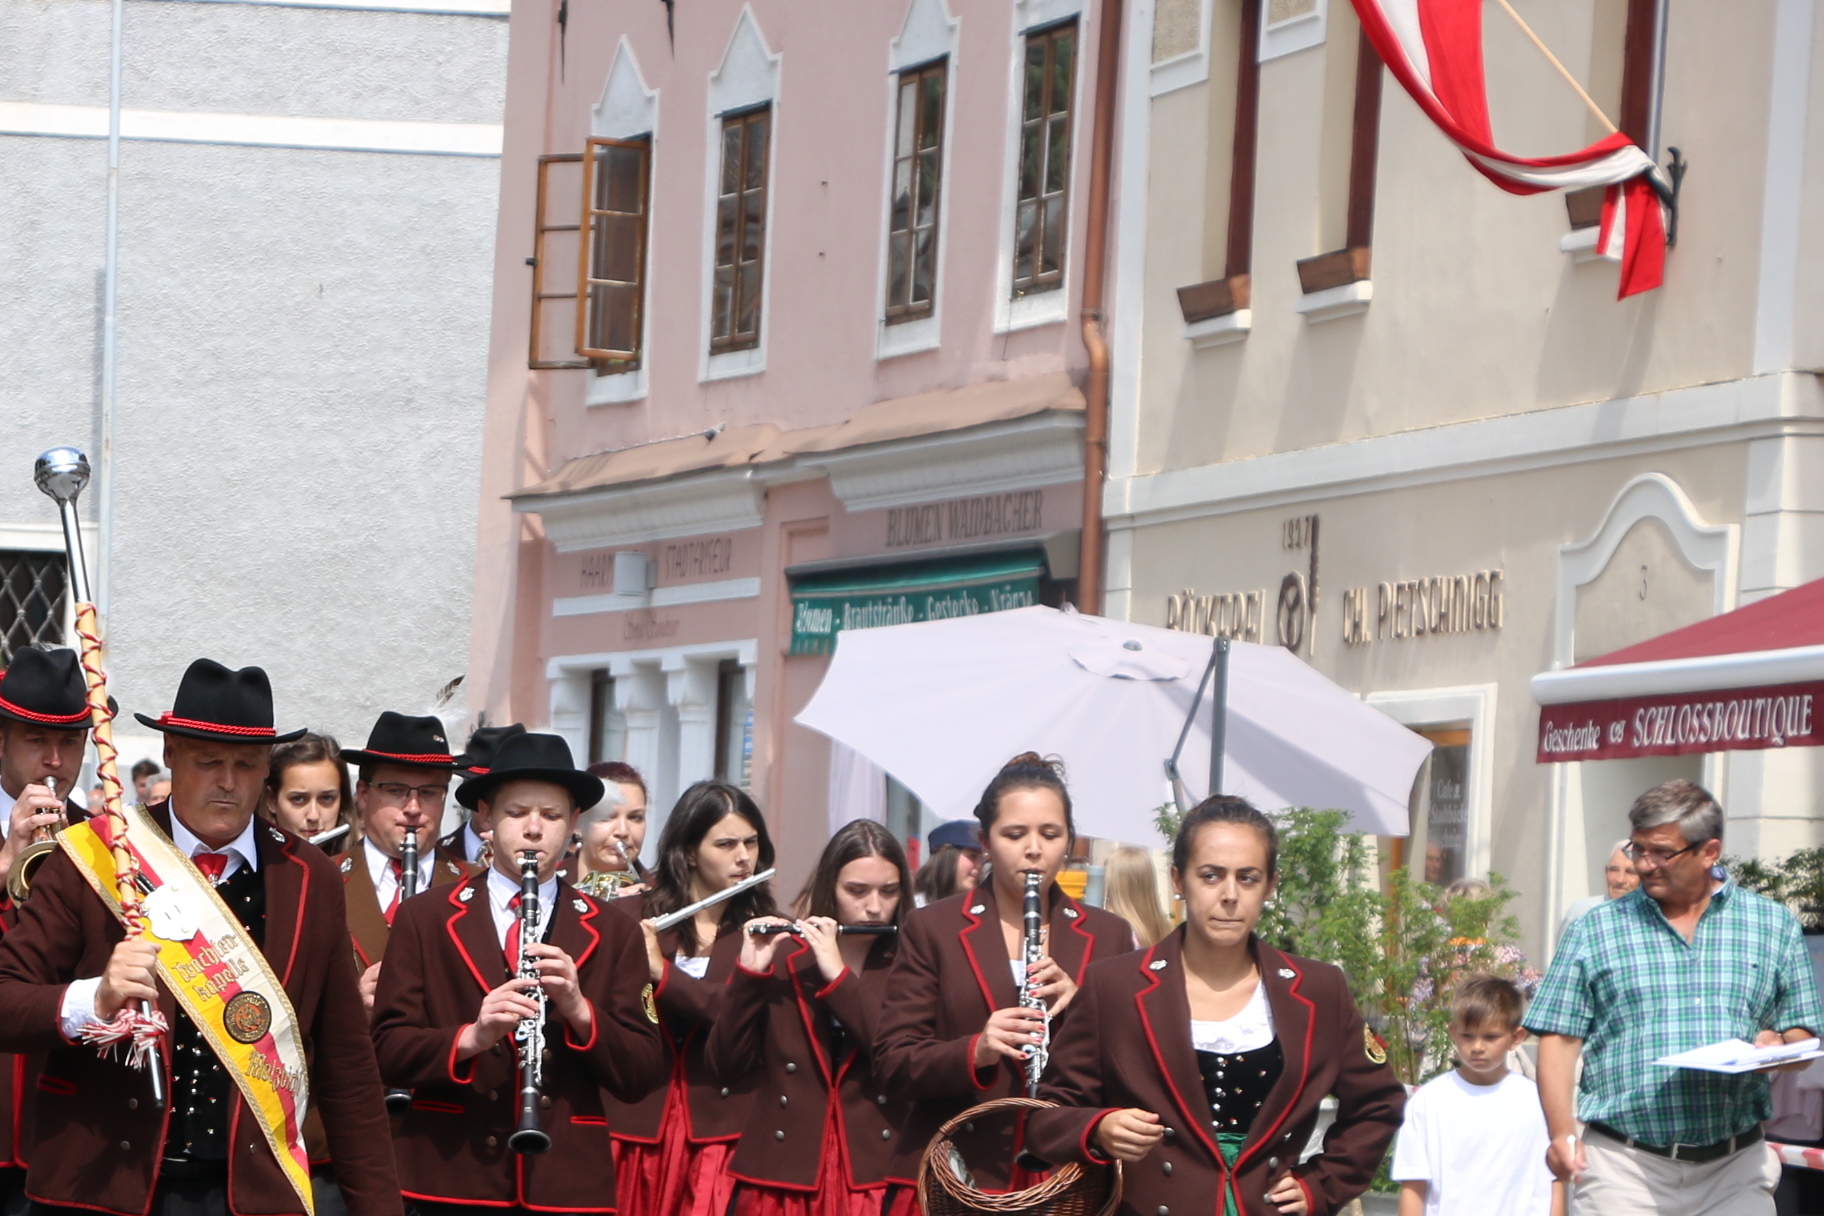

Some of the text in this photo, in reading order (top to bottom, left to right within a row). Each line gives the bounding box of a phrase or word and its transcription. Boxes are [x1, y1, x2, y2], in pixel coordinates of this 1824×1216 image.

[887, 490, 1043, 547] BLUMEN WAIDBACHER
[1378, 568, 1504, 640] PIETSCHNIGG
[1639, 564, 1648, 600] 3
[1544, 719, 1601, 752] Geschenke
[1633, 695, 1813, 748] SCHLOSSBOUTIQUE
